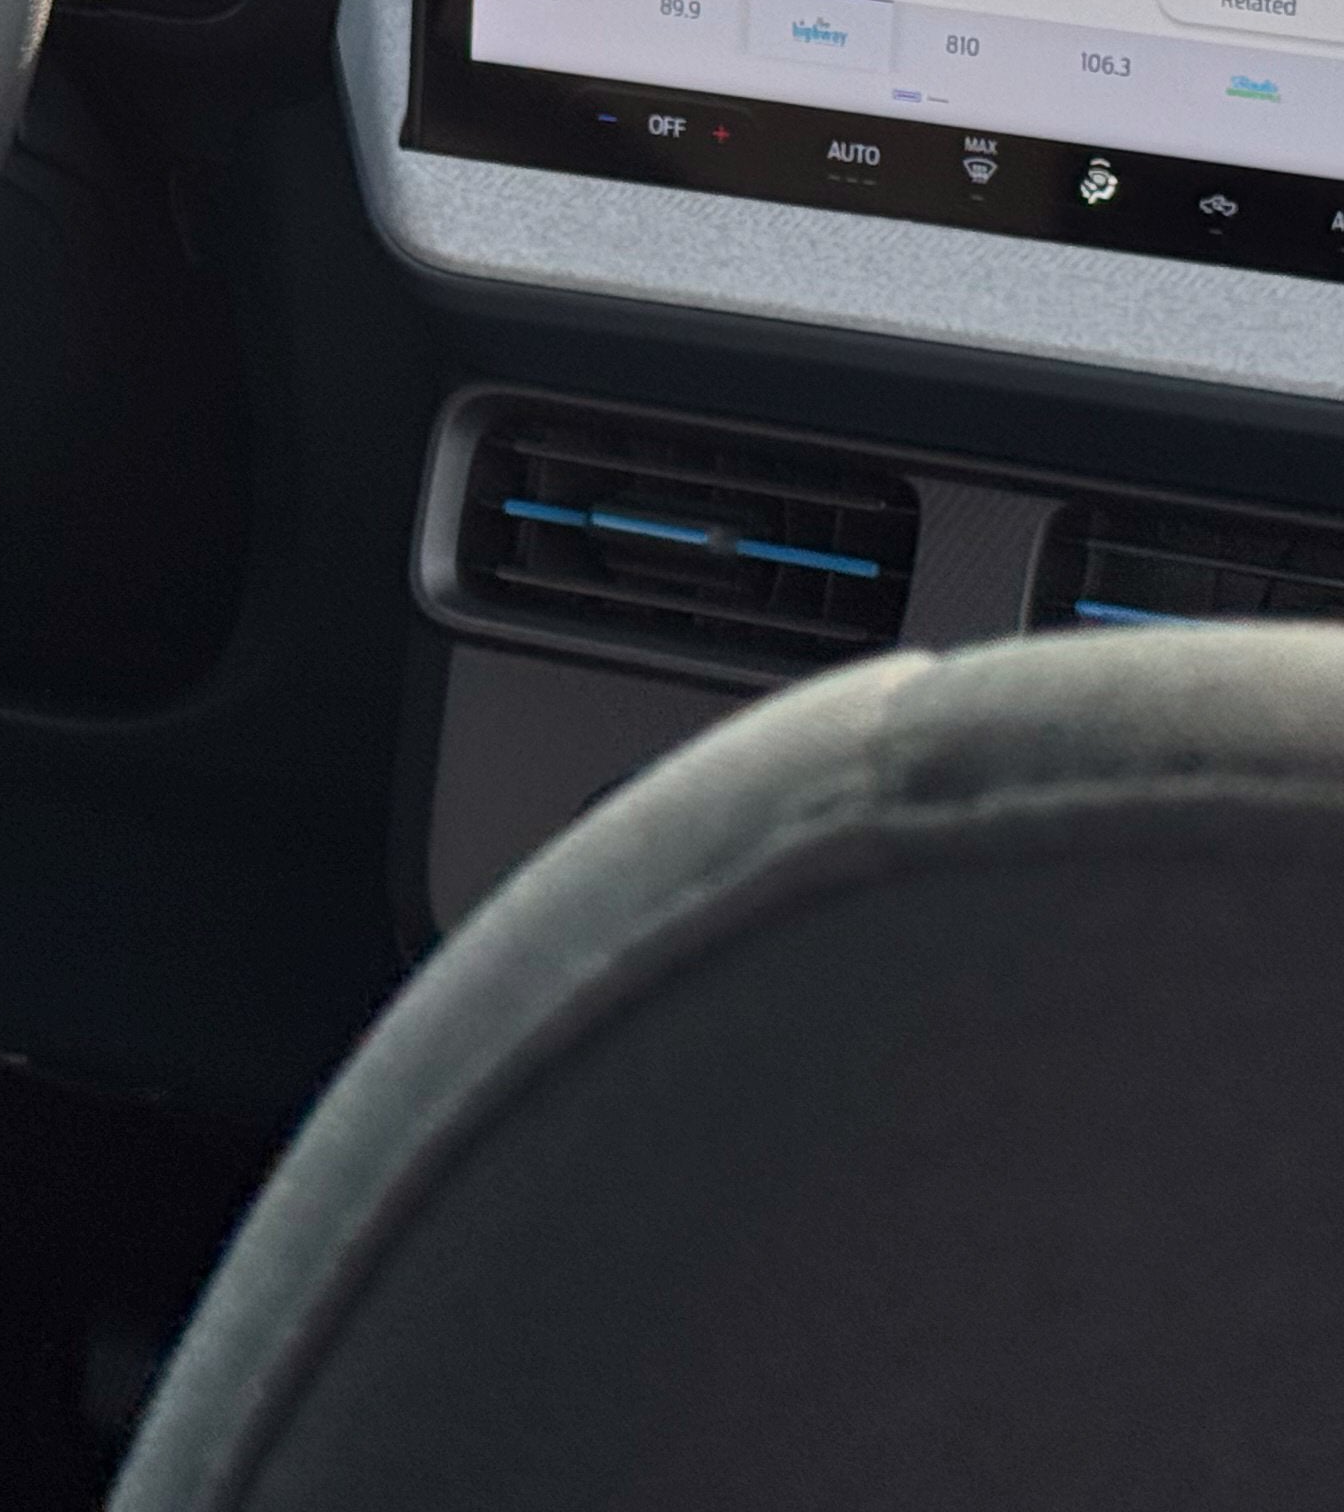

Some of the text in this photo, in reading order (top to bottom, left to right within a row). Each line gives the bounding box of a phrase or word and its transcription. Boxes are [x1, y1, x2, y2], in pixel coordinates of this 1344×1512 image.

[946, 35, 979, 57] 810
[1080, 50, 1131, 77] 106.3
[648, 114, 687, 139] OFF
[827, 140, 880, 166] AUTO
[964, 135, 998, 156] MAX
